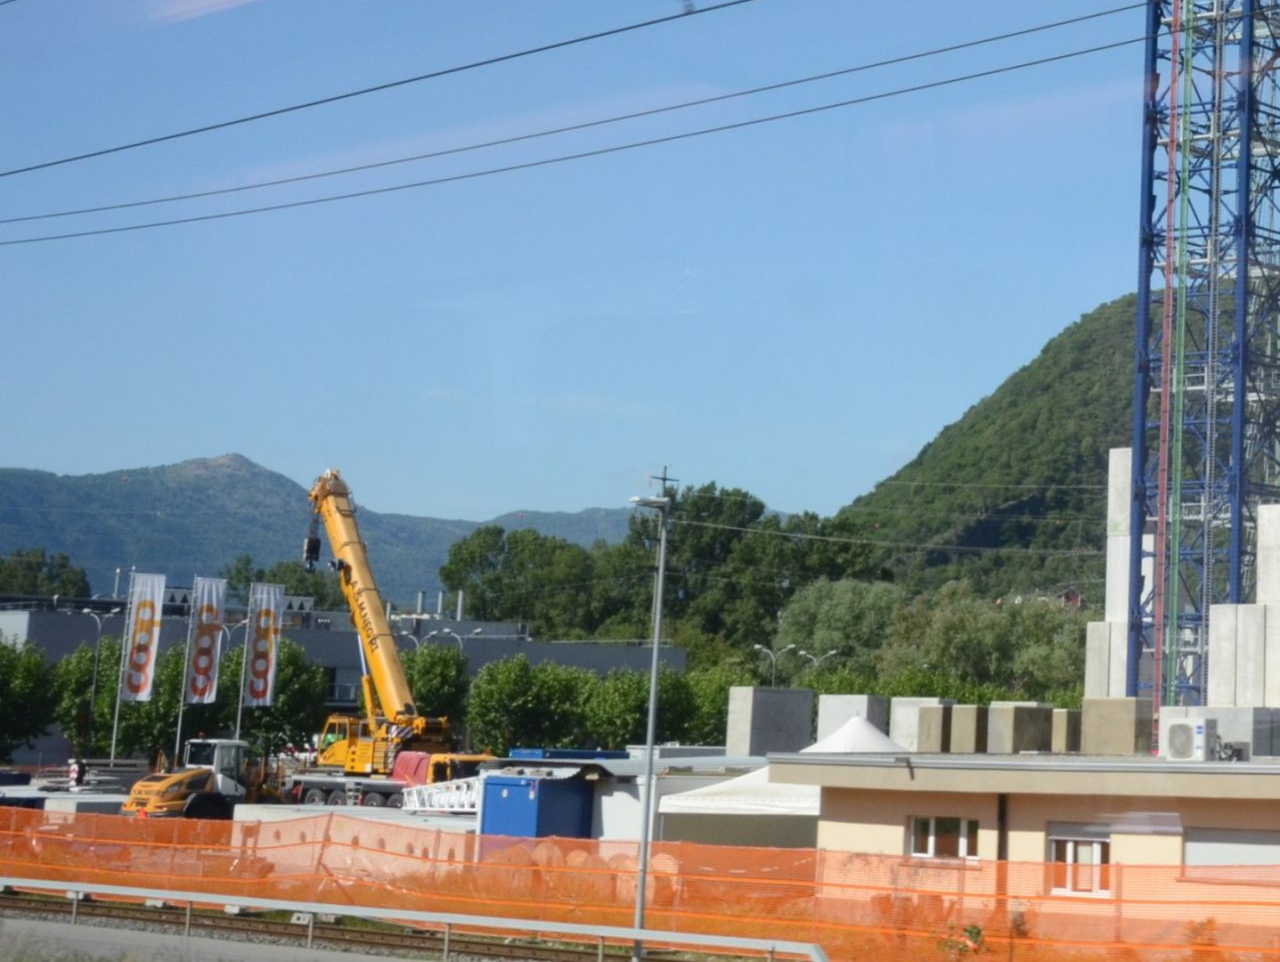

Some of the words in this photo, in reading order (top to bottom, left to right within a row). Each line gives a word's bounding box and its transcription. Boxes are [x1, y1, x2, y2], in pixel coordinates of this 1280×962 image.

[127, 599, 161, 694] coop
[191, 604, 223, 697] coop
[249, 608, 283, 699] coop
